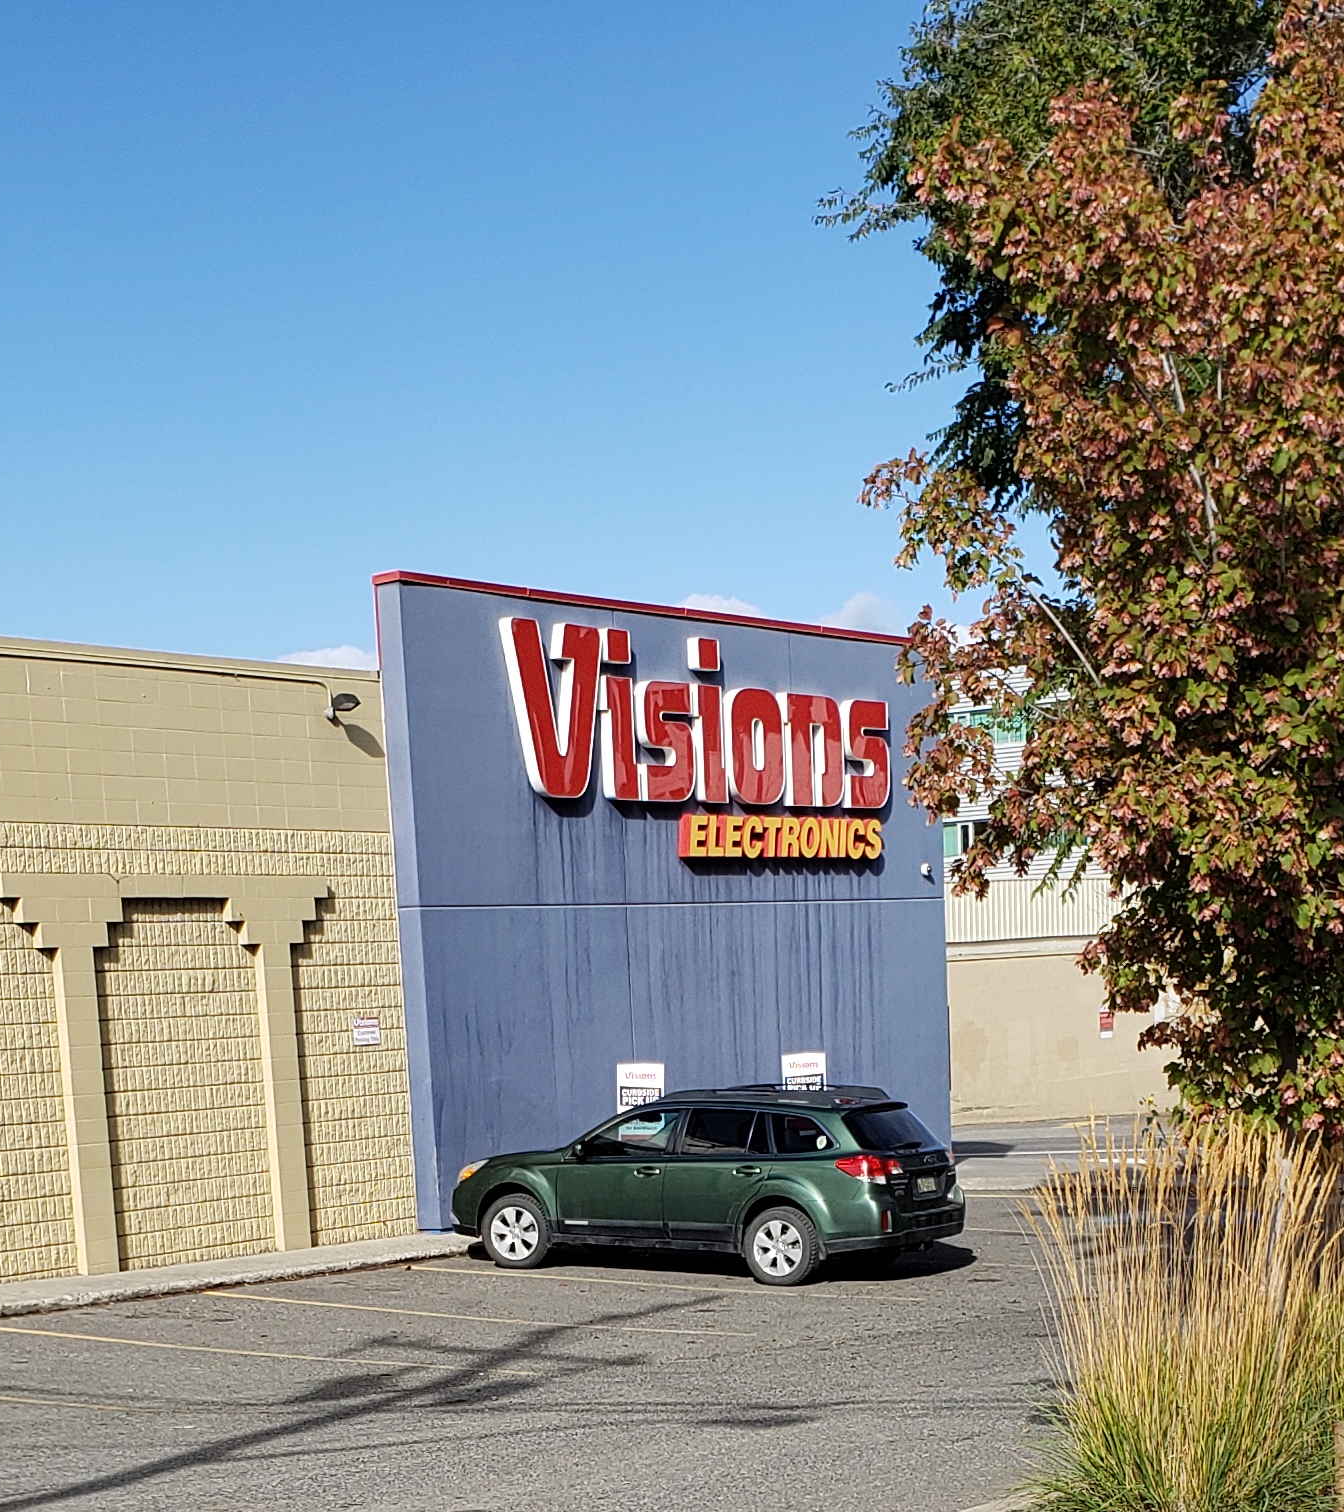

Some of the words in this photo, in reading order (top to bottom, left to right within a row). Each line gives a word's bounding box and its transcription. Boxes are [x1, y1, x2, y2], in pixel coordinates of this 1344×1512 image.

[499, 617, 891, 809] Visions
[682, 813, 883, 859] ELECTRONICS
[622, 1096, 644, 1106] PICK
